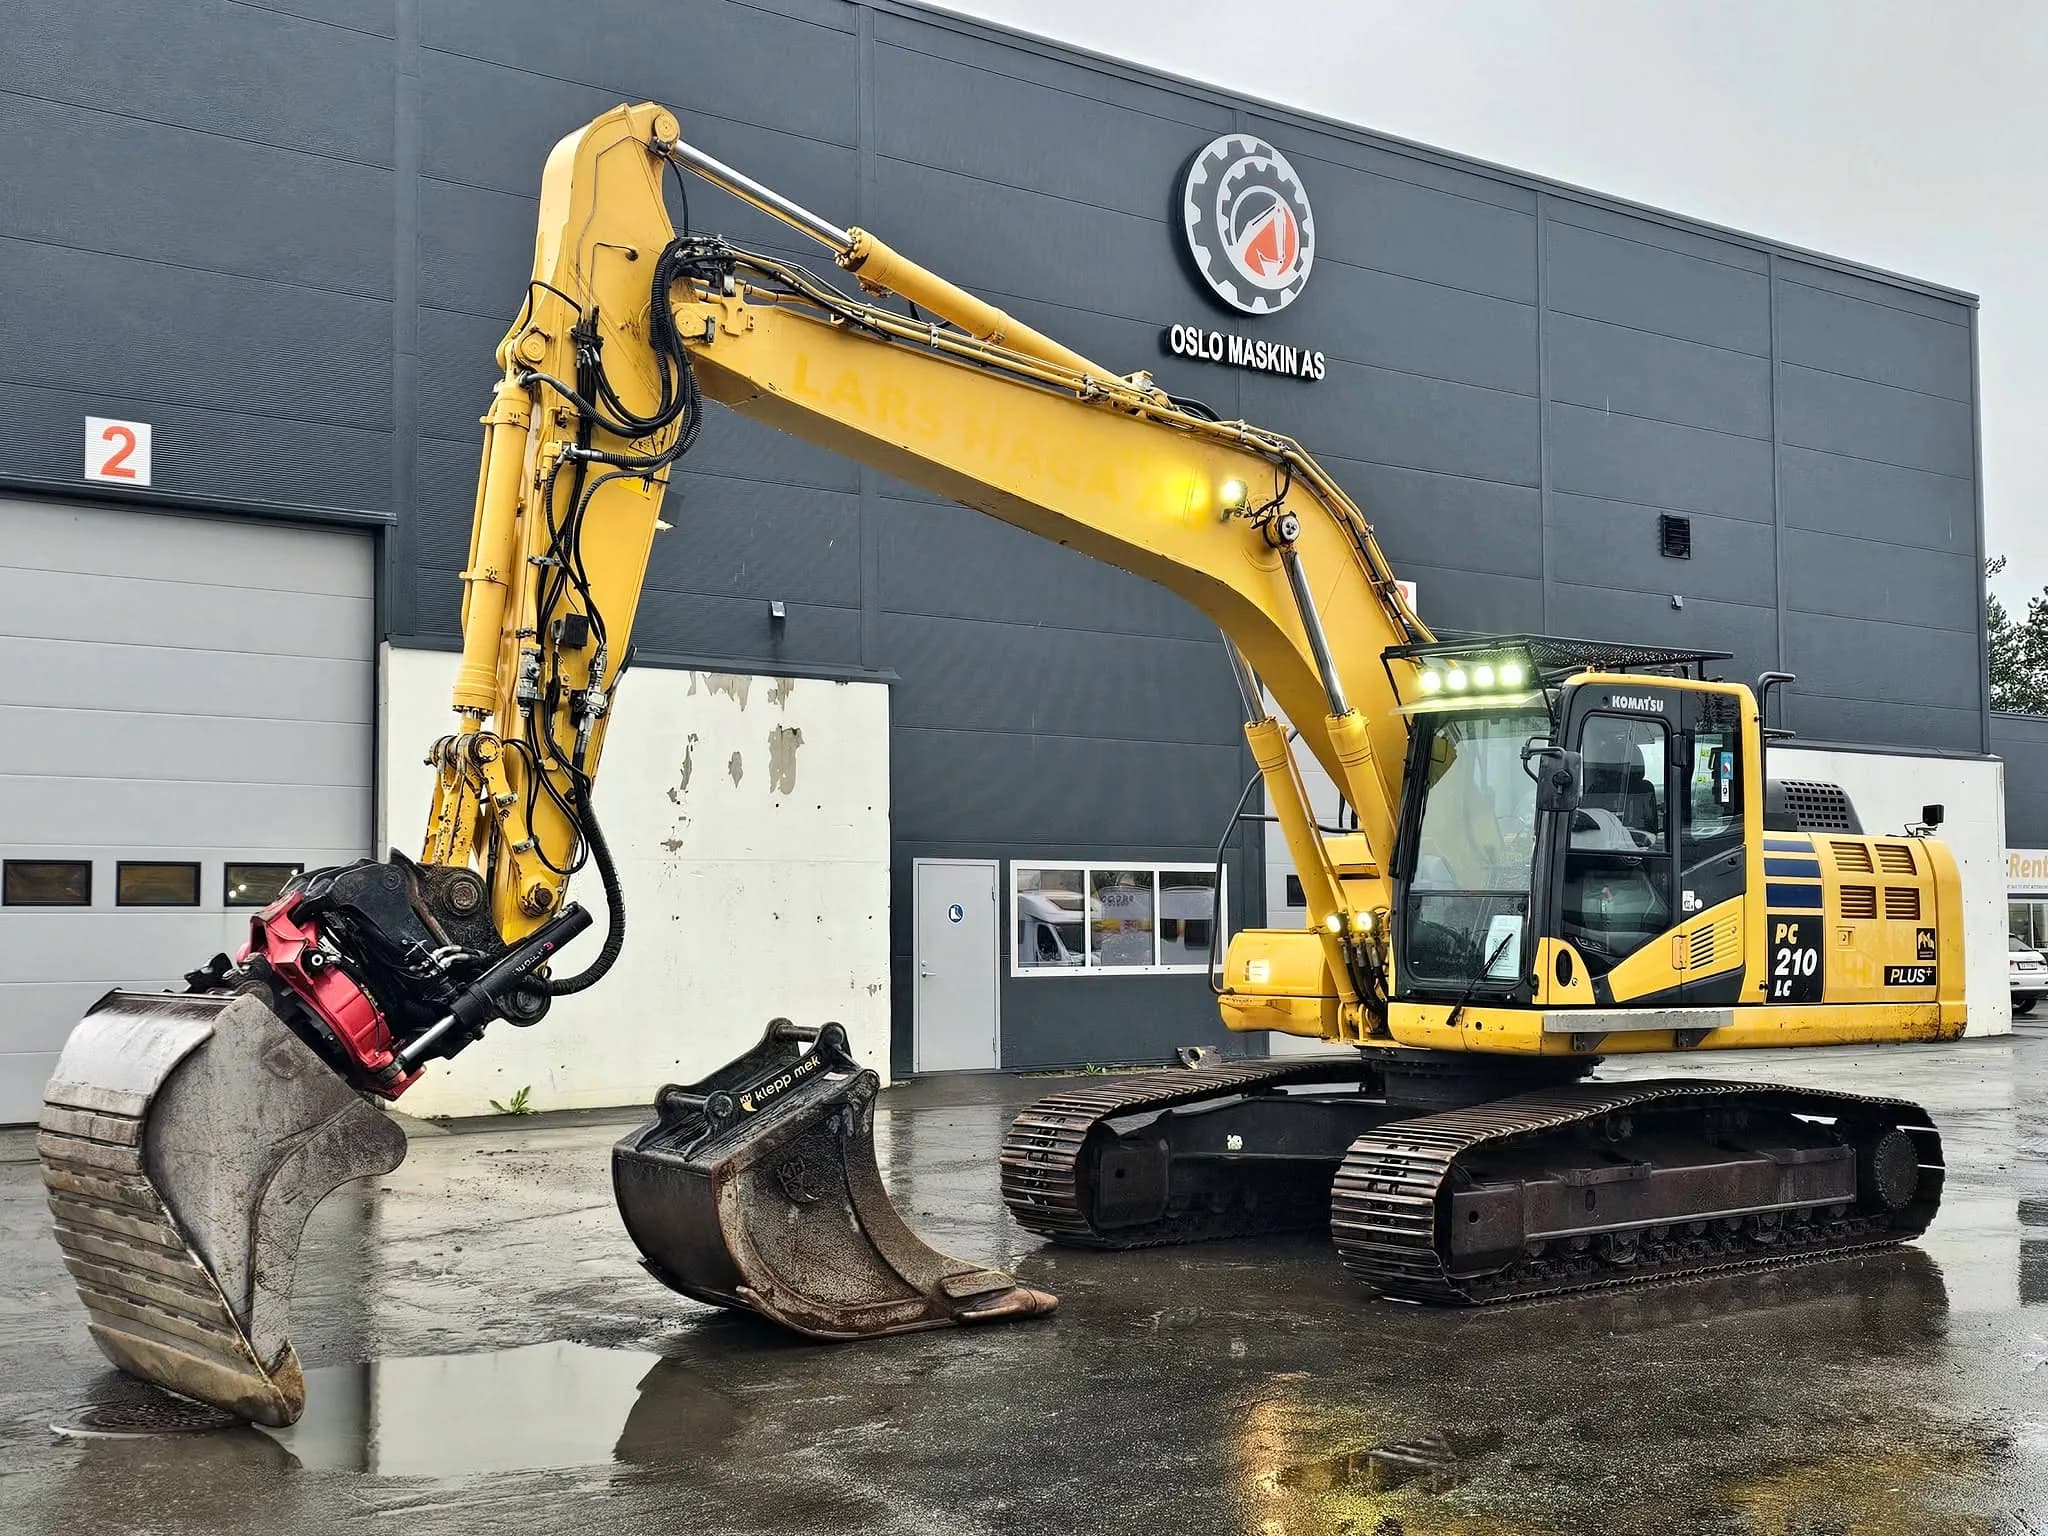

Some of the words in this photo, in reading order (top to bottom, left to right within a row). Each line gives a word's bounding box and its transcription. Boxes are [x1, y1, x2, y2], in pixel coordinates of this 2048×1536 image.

[1170, 324, 1224, 361] OSLO
[1228, 334, 1298, 375] MASKIN
[1300, 350, 1326, 380] AS
[793, 351, 943, 439] LARS
[101, 426, 136, 478] 2
[1612, 695, 1664, 712] KOMATSU
[2006, 853, 2048, 878] Rent
[1775, 923, 1799, 945] PC
[1774, 947, 1818, 977] 210
[1774, 979, 1793, 997] LC
[754, 1074, 791, 1102] klepp
[794, 1055, 821, 1078] mek
